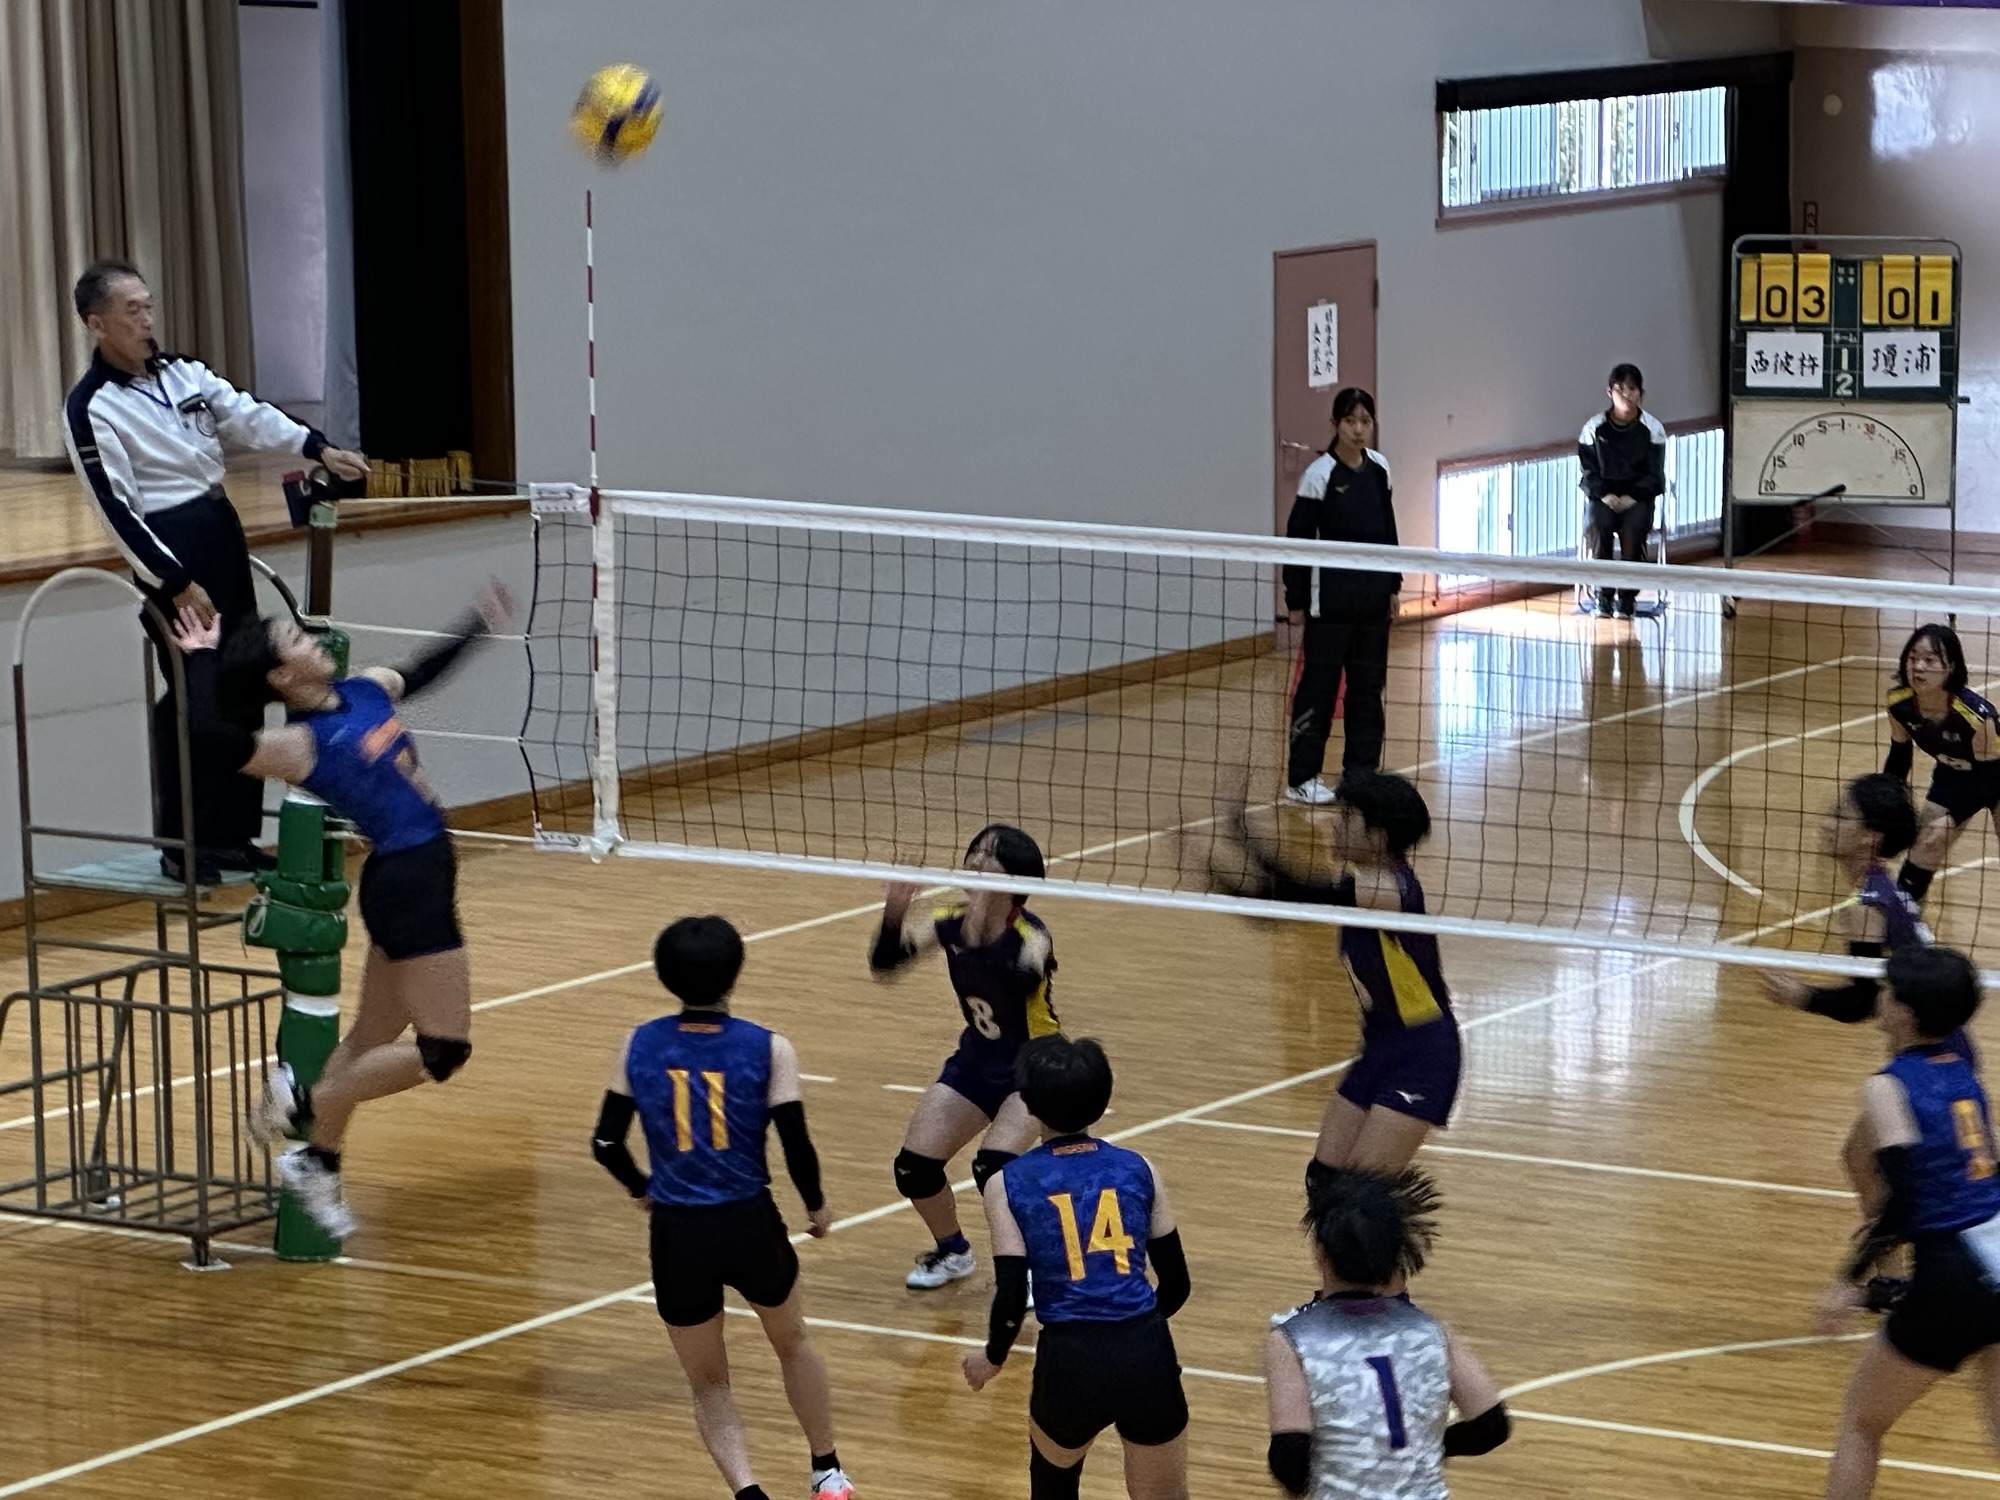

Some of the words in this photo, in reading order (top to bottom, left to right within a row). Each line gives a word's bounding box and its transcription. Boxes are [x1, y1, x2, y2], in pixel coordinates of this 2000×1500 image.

[1765, 284, 1826, 318] 03
[1888, 286, 1940, 321] 01
[1835, 372, 1854, 396] 2
[1792, 433, 1805, 448] 10
[1817, 420, 1827, 435] 5
[1772, 455, 1787, 468] 15
[965, 996, 1001, 1040] 8
[665, 1068, 730, 1152] 11
[1047, 1187, 1135, 1282] 14
[1364, 1355, 1406, 1449] 1
